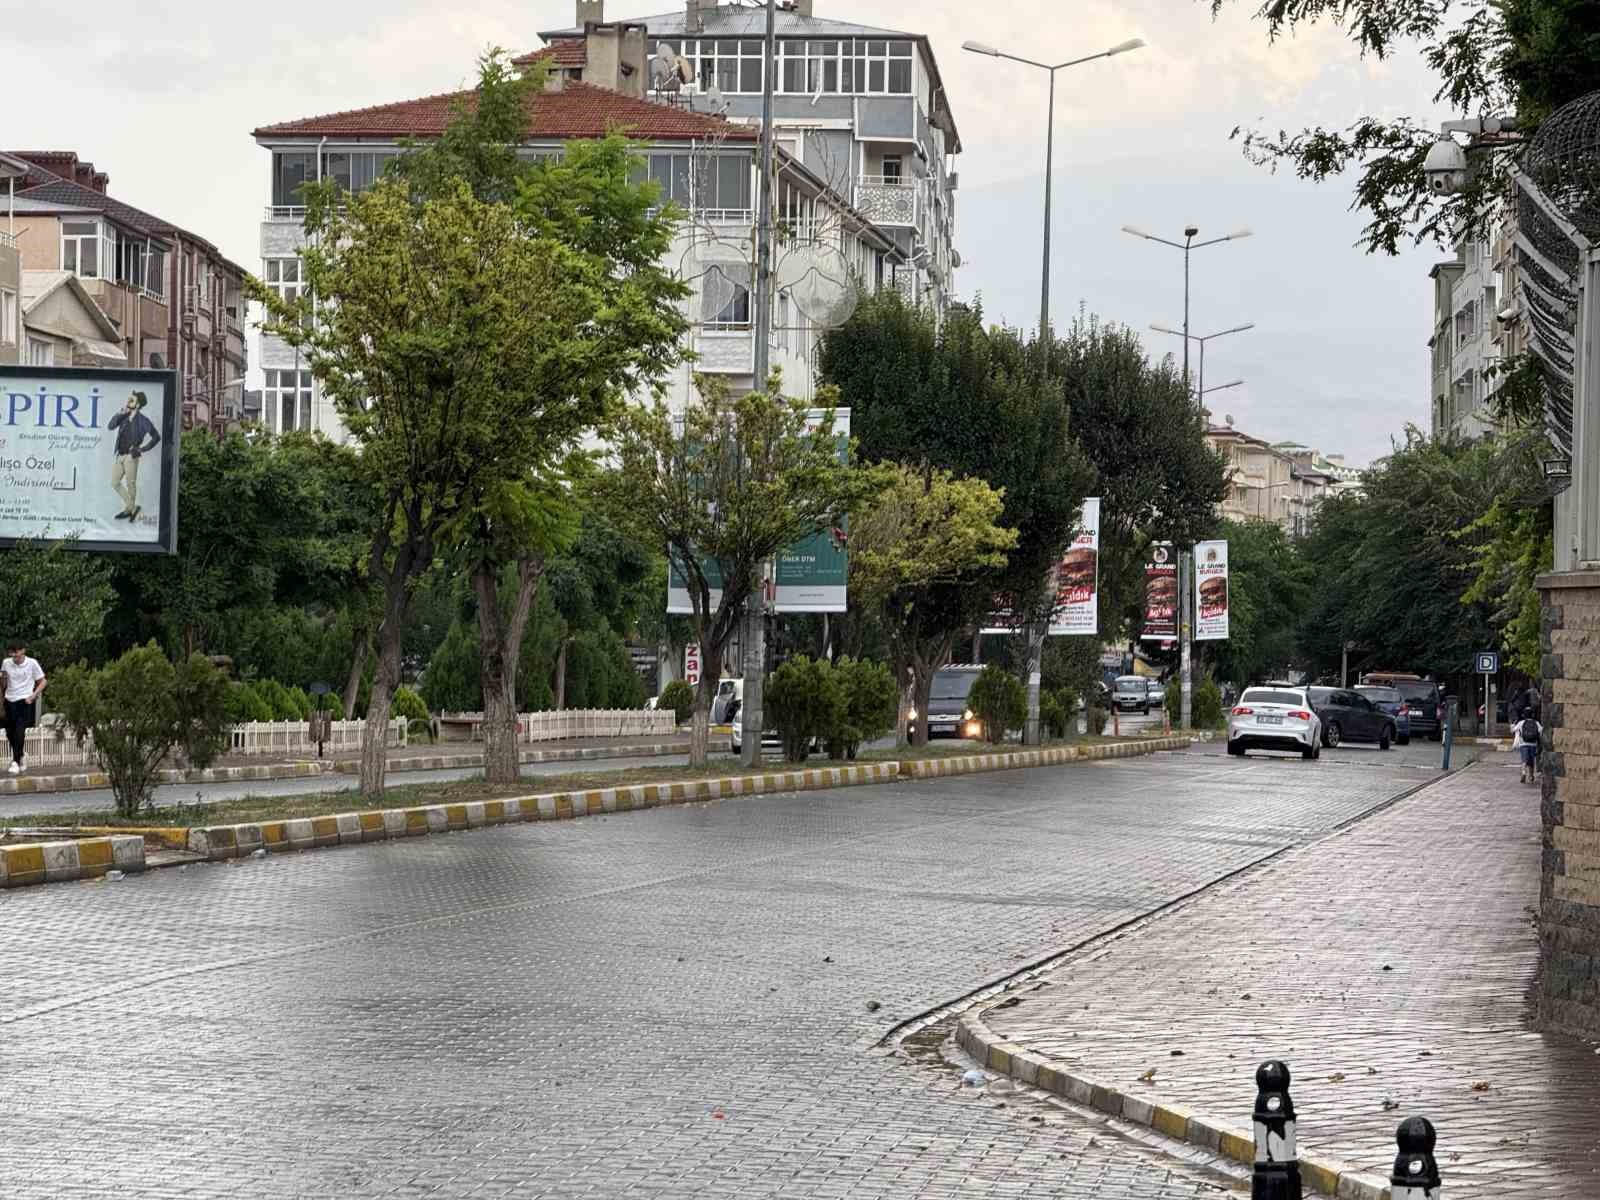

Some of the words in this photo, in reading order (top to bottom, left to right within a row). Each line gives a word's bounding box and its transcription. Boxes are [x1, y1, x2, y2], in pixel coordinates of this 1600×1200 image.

[0, 386, 104, 429] PİRİ
[25, 454, 55, 471] Özel
[1482, 657, 1492, 668] D
